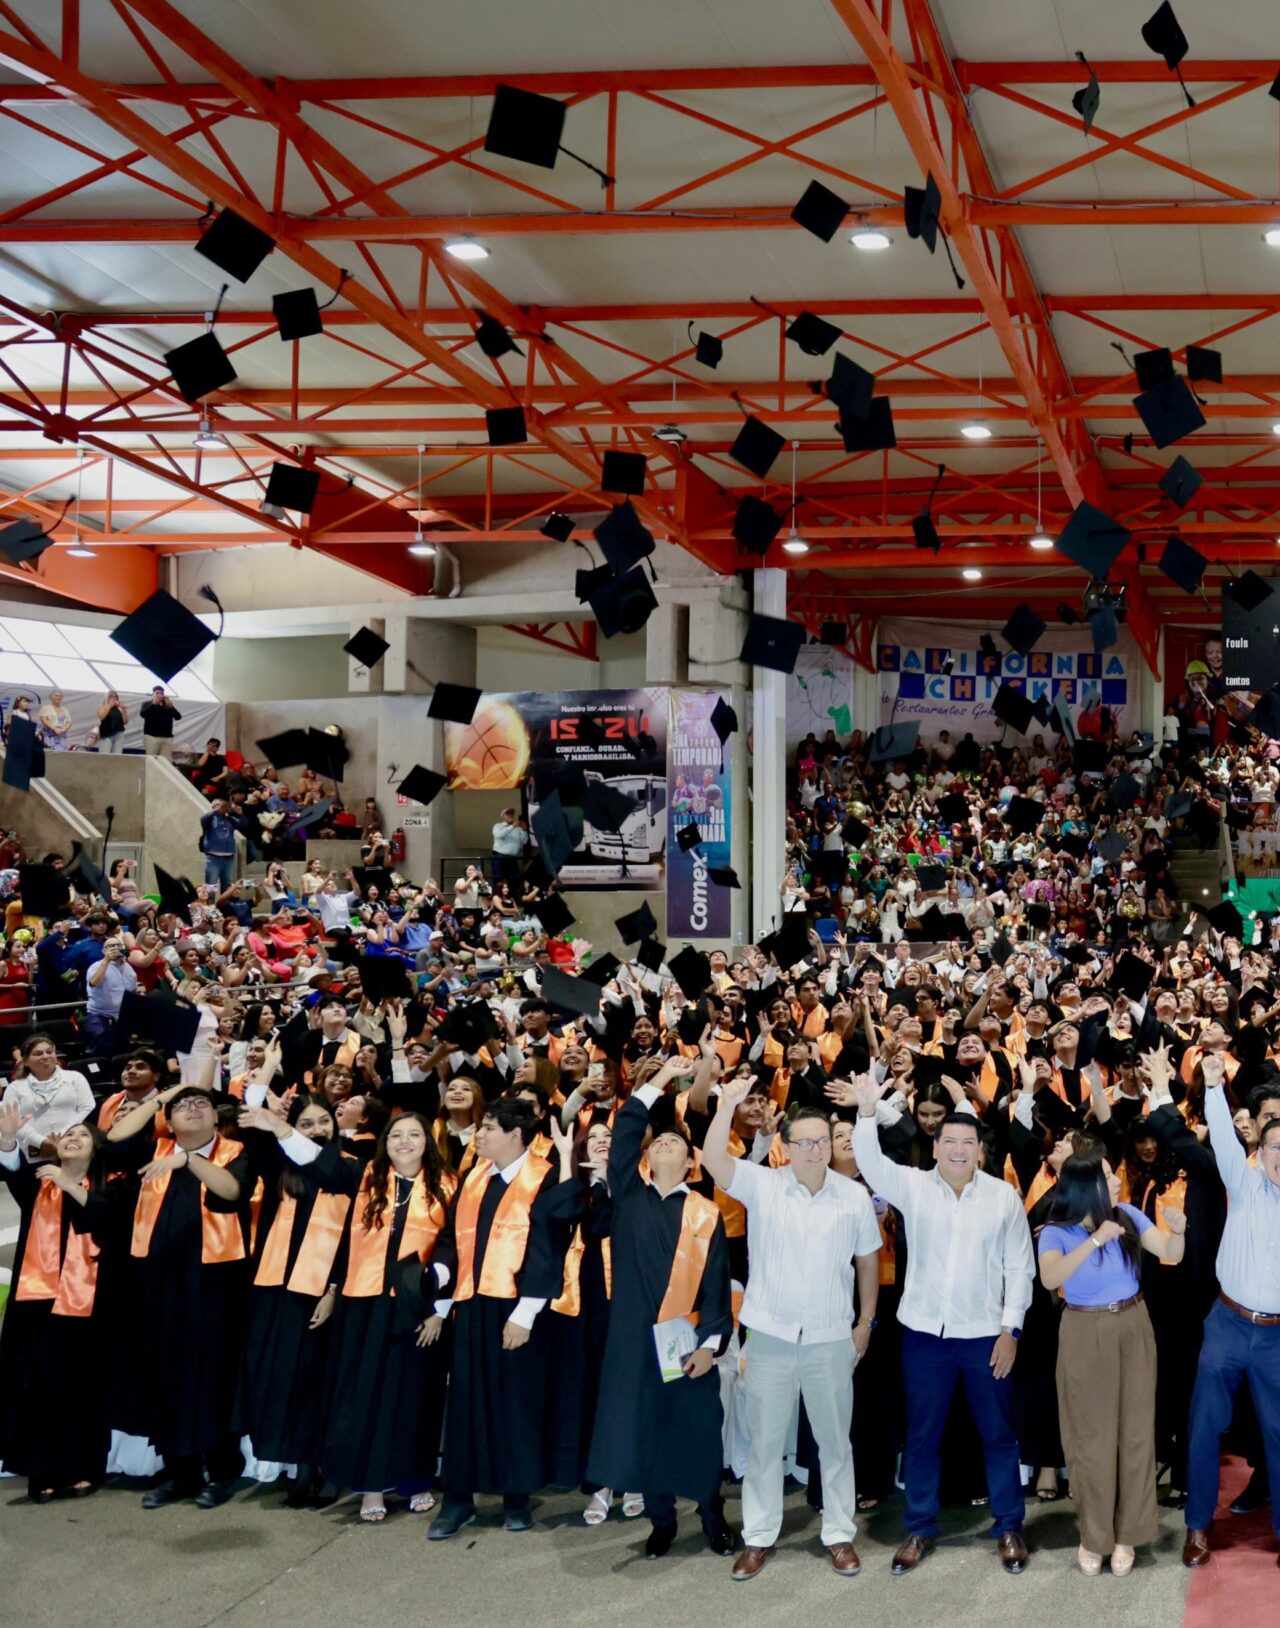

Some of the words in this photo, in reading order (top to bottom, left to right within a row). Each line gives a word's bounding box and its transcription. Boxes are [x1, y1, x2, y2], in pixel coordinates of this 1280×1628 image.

[1226, 637, 1249, 649] fouls
[1226, 675, 1250, 686] tantos
[562, 705, 585, 713] Nuestro
[892, 700, 967, 716] Restaurantes
[550, 716, 650, 739] ISZU
[405, 818, 422, 826] ZONA
[689, 848, 708, 931] Comex
